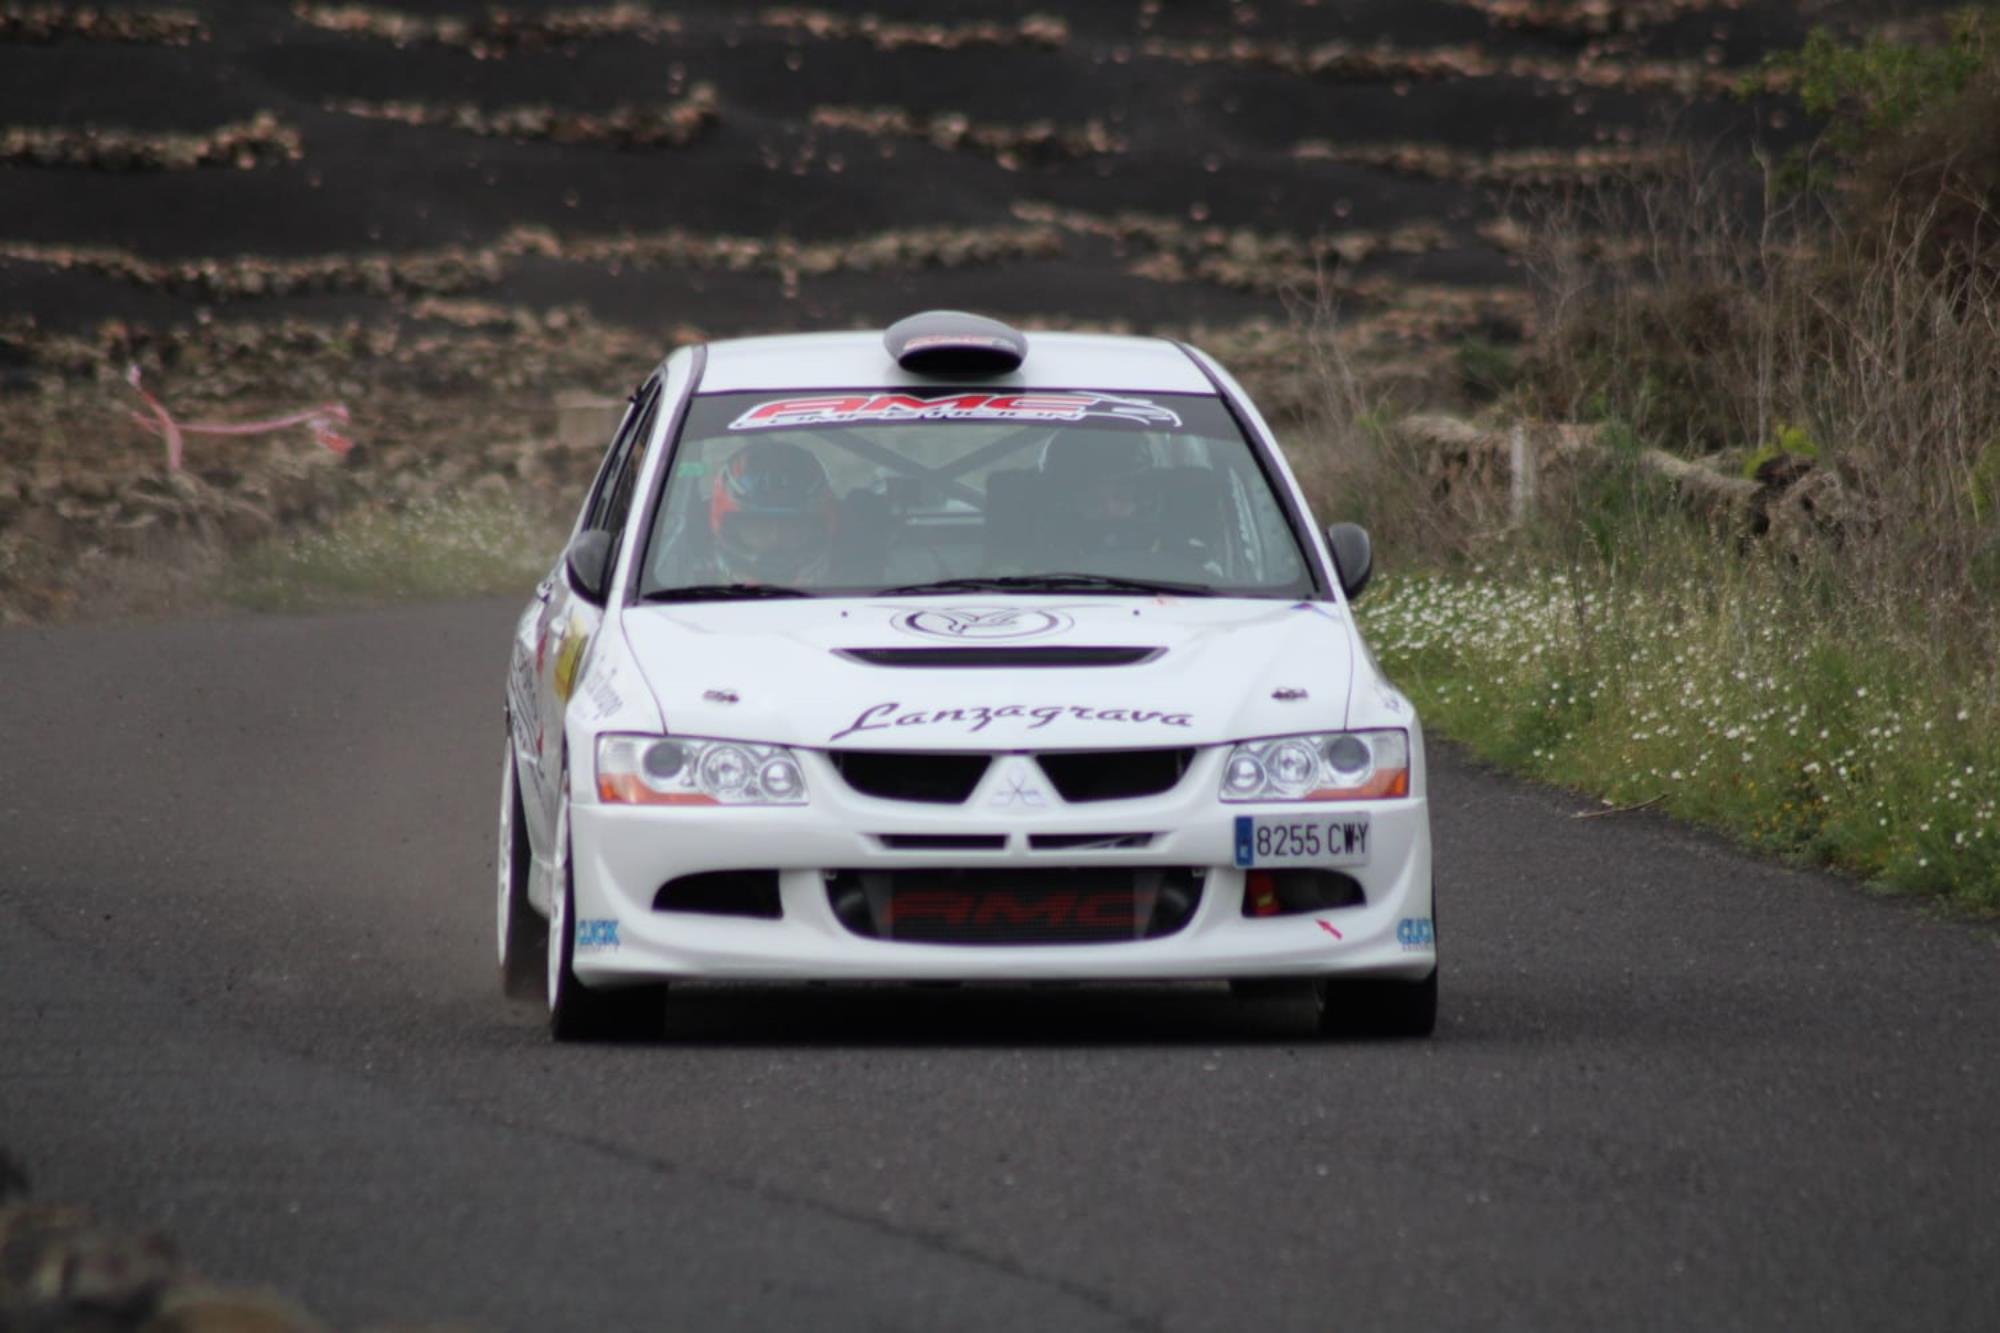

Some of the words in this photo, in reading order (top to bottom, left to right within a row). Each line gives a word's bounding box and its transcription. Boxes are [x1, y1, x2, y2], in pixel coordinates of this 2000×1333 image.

[829, 702, 1193, 742] Lanzagrava
[1256, 824, 1320, 857] 8255
[1328, 822, 1369, 855] CWY
